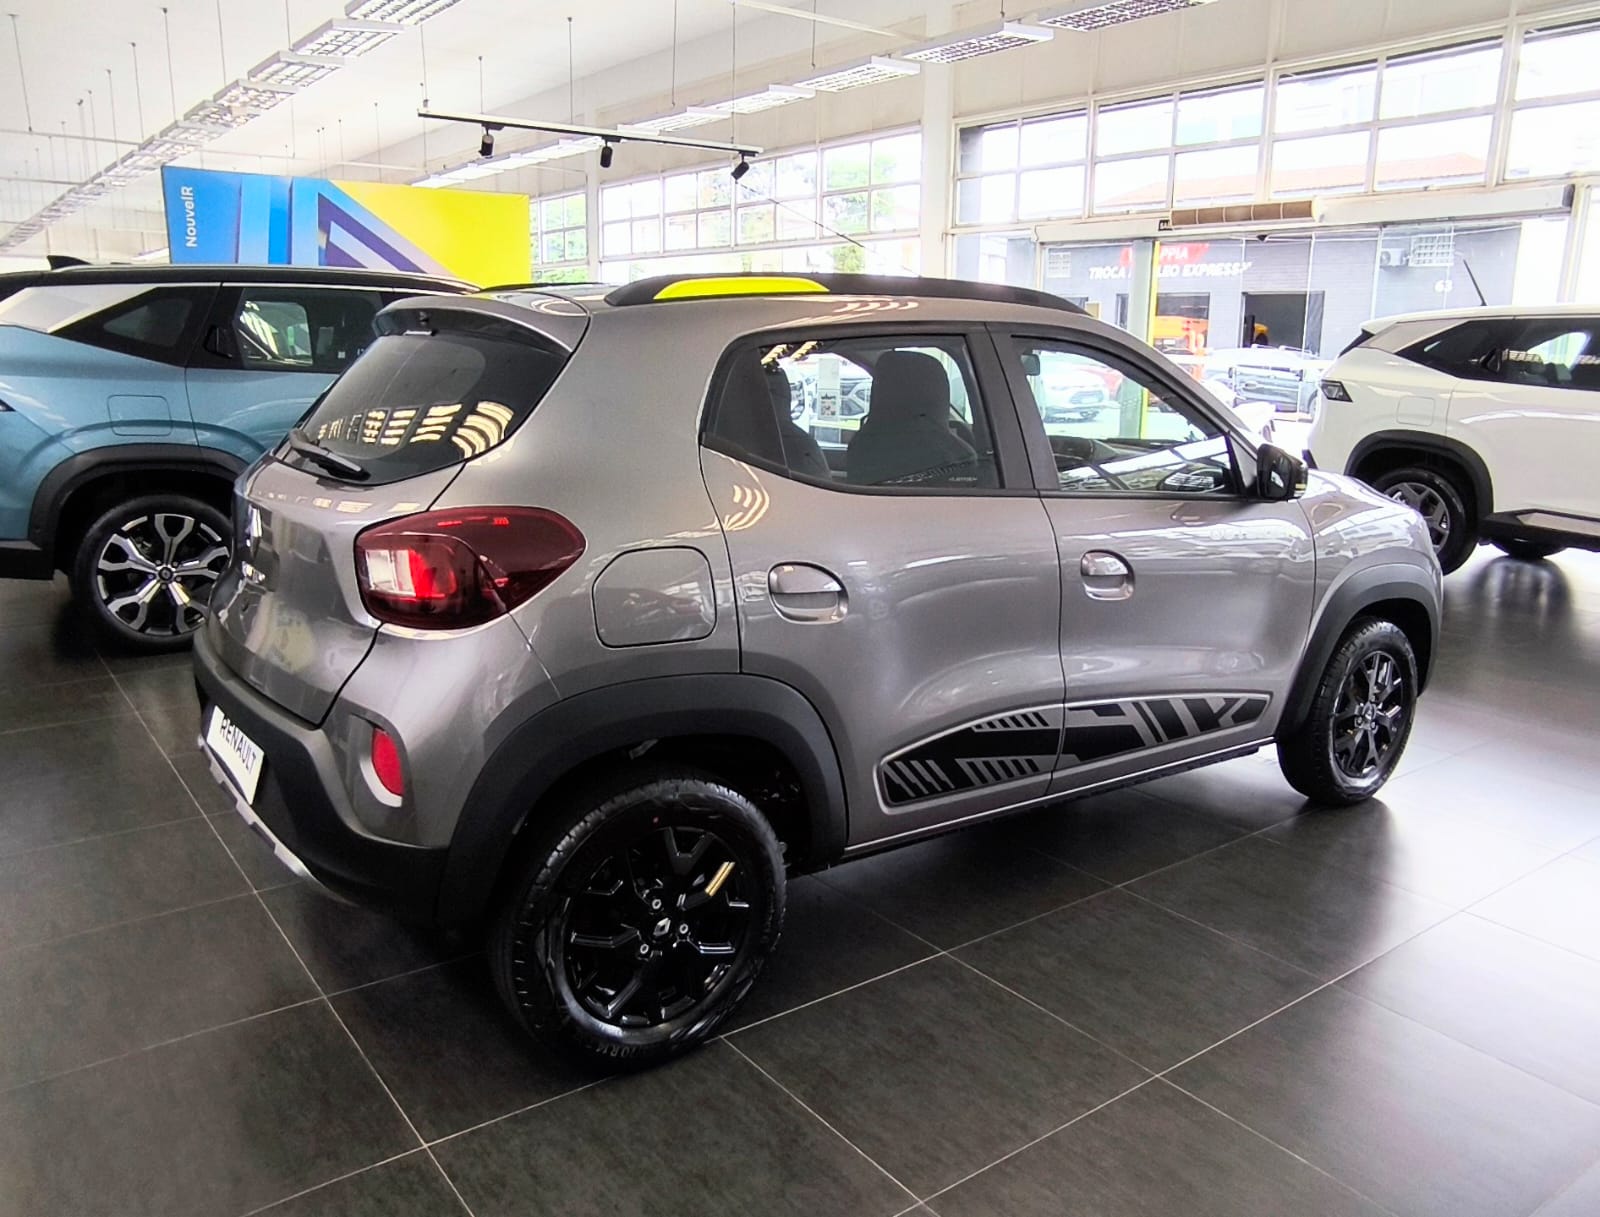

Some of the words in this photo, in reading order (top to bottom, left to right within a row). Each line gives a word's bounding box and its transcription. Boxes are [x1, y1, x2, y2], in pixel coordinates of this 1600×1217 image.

[1160, 246, 1188, 260] PPIA
[1089, 265, 1126, 280] TROCA
[1158, 263, 1180, 278] LEO
[219, 717, 257, 775] RENAULT
